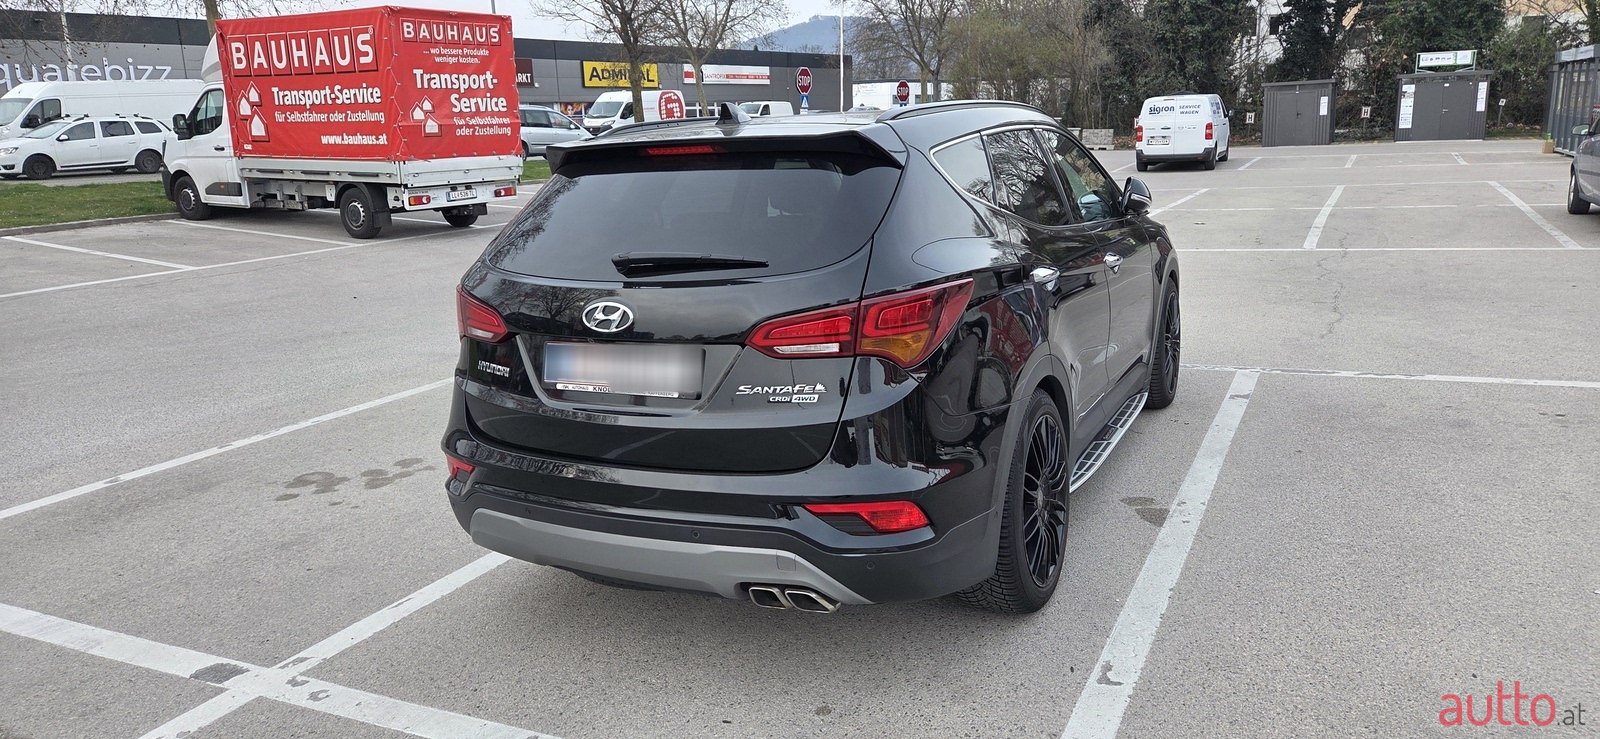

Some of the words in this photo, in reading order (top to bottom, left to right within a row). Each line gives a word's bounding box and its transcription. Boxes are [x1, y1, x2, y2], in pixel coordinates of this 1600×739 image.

[403, 22, 500, 42] BAUHAUS
[231, 33, 374, 70] BAUHAUS
[440, 47, 462, 55] bessere
[463, 47, 490, 56] Produkte
[434, 55, 459, 64] weniger
[412, 69, 498, 93] Transport-
[798, 75, 811, 84] STOP
[271, 83, 382, 108] Transport-Service
[897, 87, 909, 96] STOP
[450, 93, 508, 113] Service
[1148, 104, 1175, 115] sigron
[1363, 107, 1369, 117] H
[275, 111, 286, 122] für
[286, 111, 328, 122] Selbstfahrer
[329, 110, 346, 122] oder
[347, 109, 385, 123] Zustellung
[456, 126, 473, 136] oder
[475, 125, 512, 136] Zustellung
[320, 132, 388, 144] www.bauhaus.at
[477, 359, 510, 378] HYUNDAI
